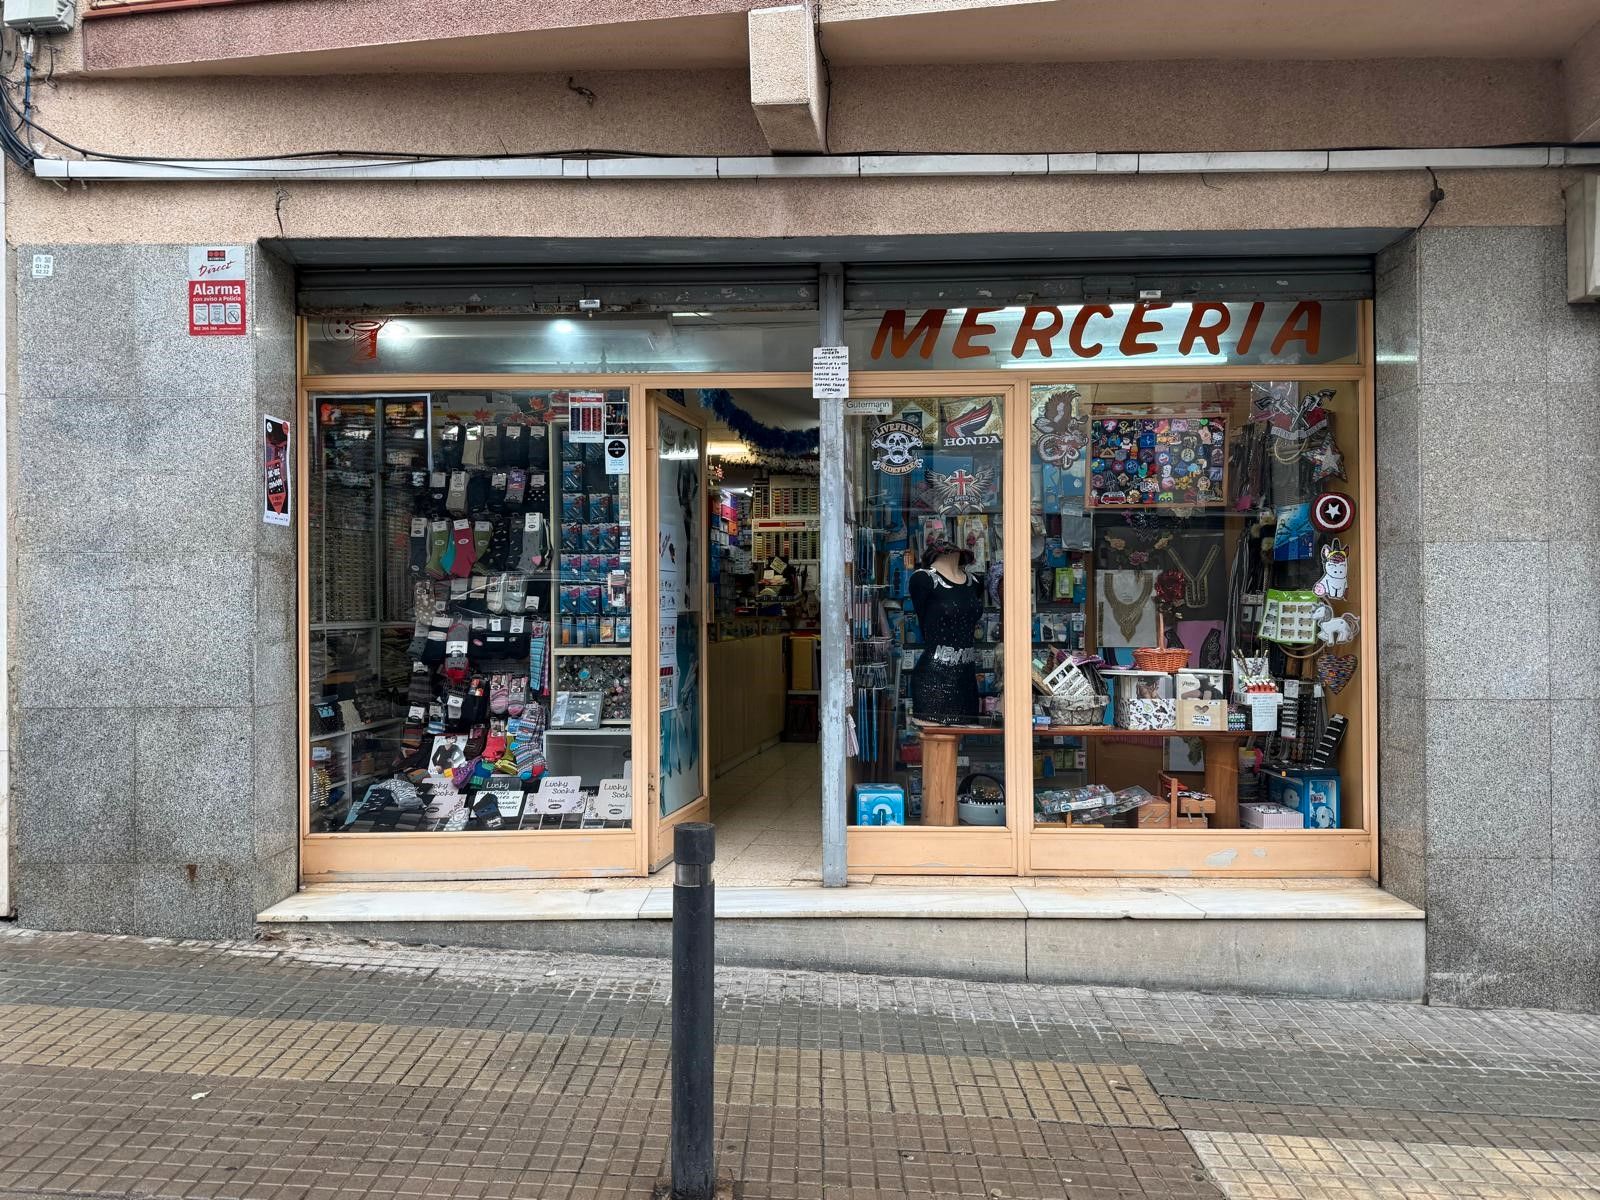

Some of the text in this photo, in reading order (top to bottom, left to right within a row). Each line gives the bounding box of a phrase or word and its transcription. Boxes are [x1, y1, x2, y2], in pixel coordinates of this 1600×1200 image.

[198, 260, 236, 277] Direct
[193, 282, 241, 295] Alarma
[871, 301, 1322, 360] MERCERIA
[943, 436, 1000, 447] HONDA
[486, 781, 510, 790] Lucky
[544, 780, 568, 788] Lucky
[604, 783, 627, 791] Lucky
[552, 787, 575, 795] Socks
